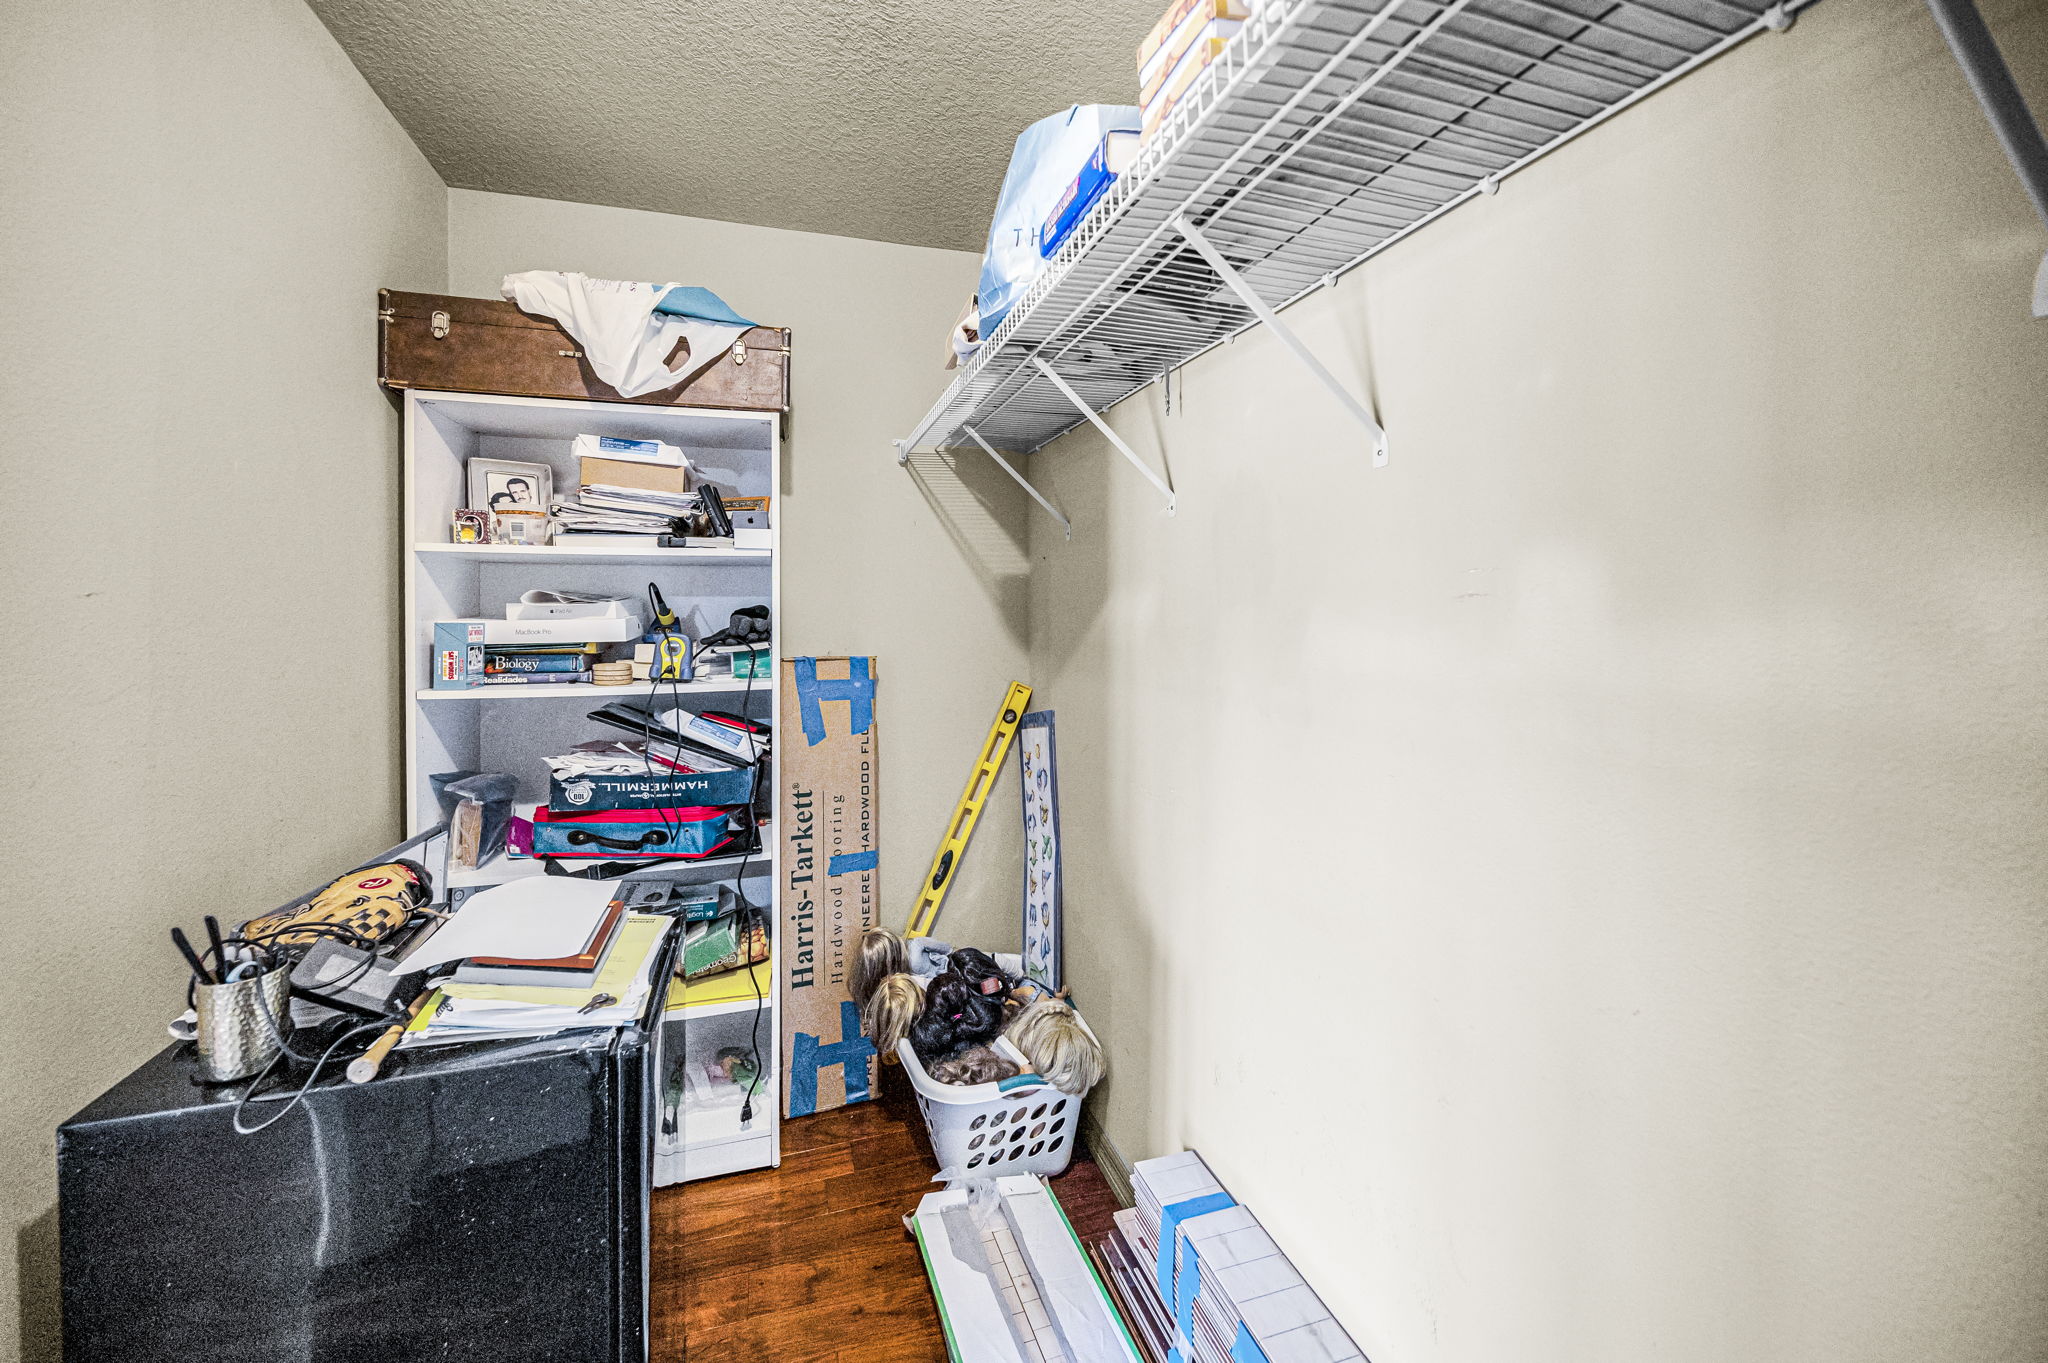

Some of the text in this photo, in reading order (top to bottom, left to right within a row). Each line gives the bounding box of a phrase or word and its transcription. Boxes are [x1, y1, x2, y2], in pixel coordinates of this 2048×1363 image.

[515, 628, 541, 636] MacBook
[495, 655, 540, 672] Biology
[830, 795, 845, 984] Hardwood ooring
